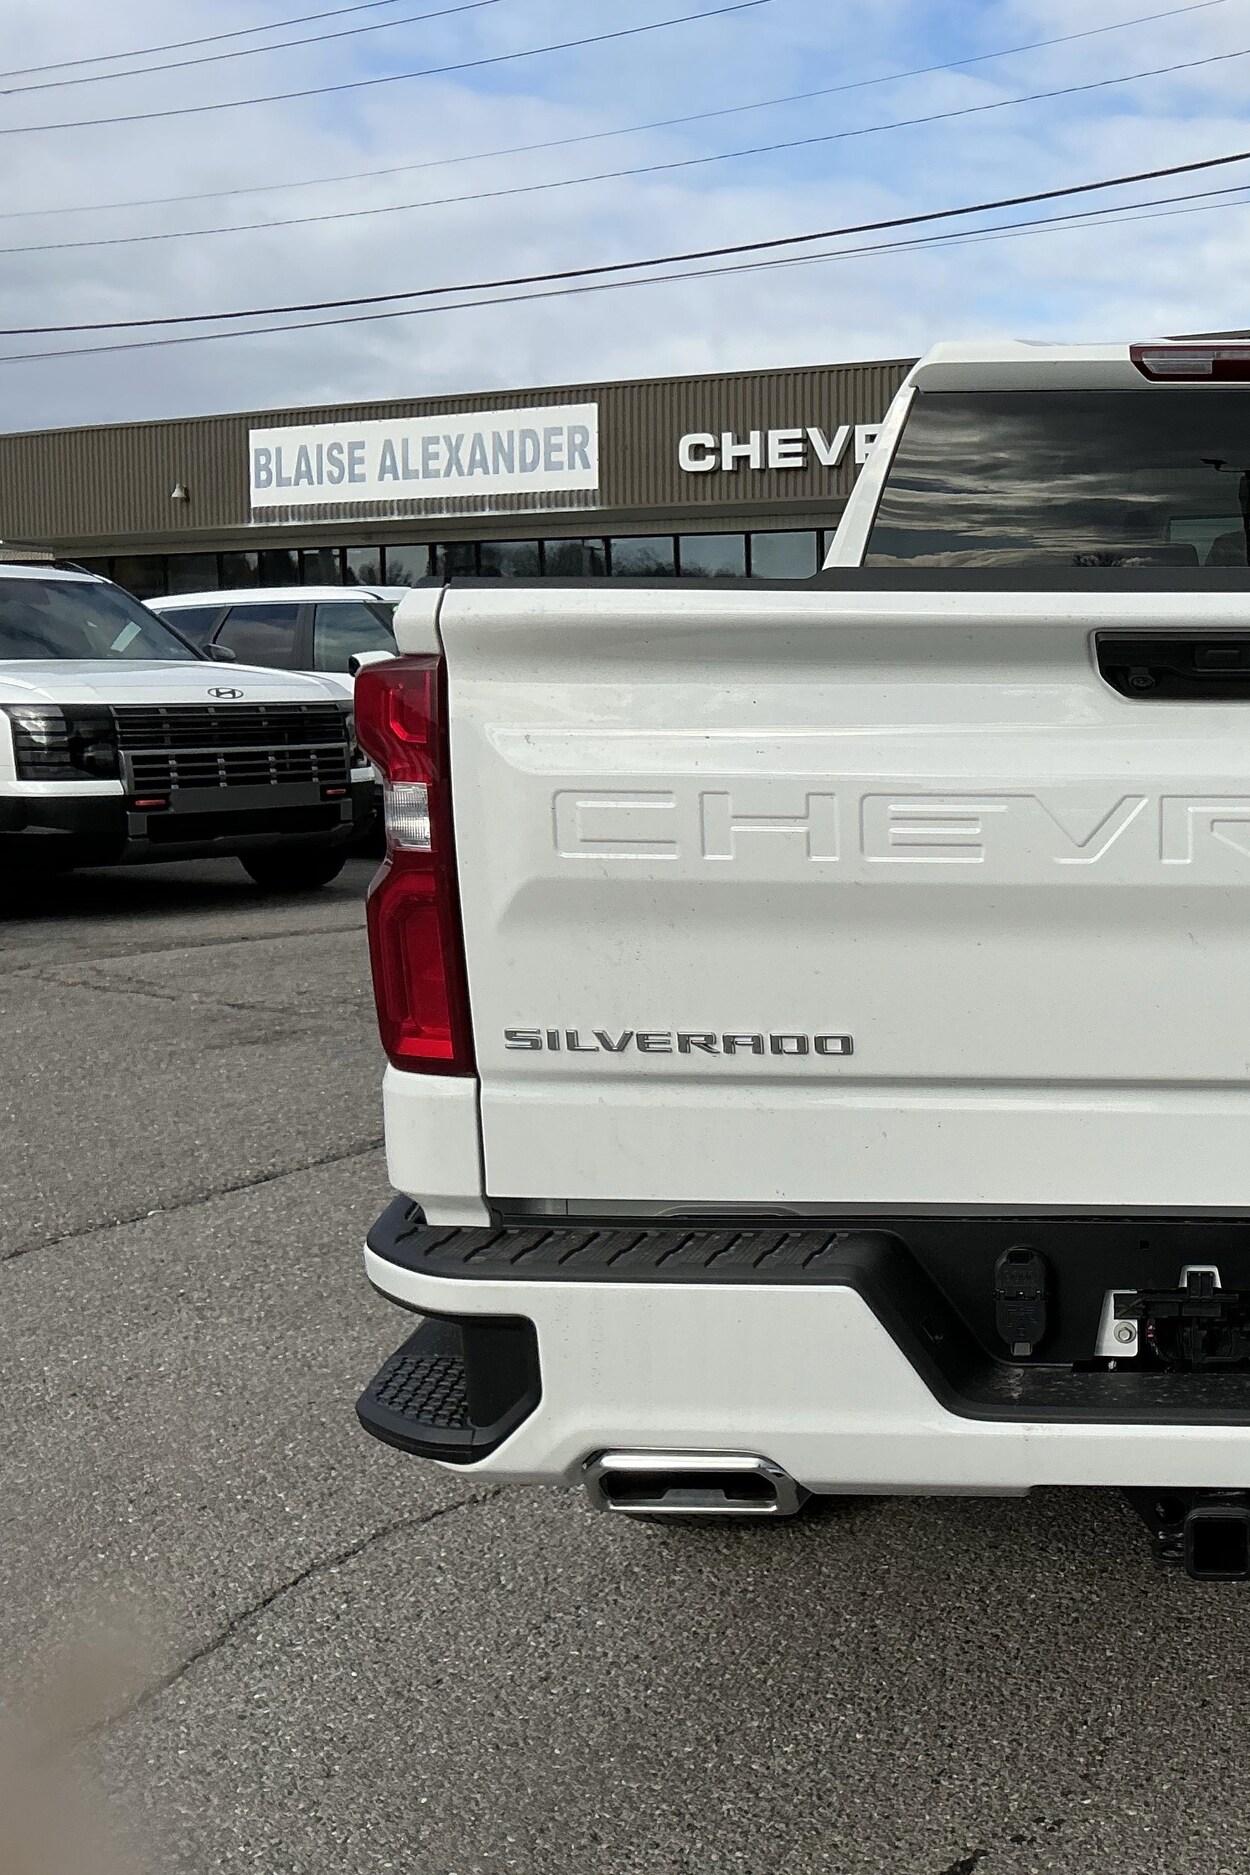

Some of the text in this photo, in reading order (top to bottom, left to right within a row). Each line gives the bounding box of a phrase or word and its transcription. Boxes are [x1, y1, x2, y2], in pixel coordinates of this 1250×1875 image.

[254, 425, 592, 489] BLAISE ALEXANDER
[504, 1027, 855, 1056] SILVERADO
